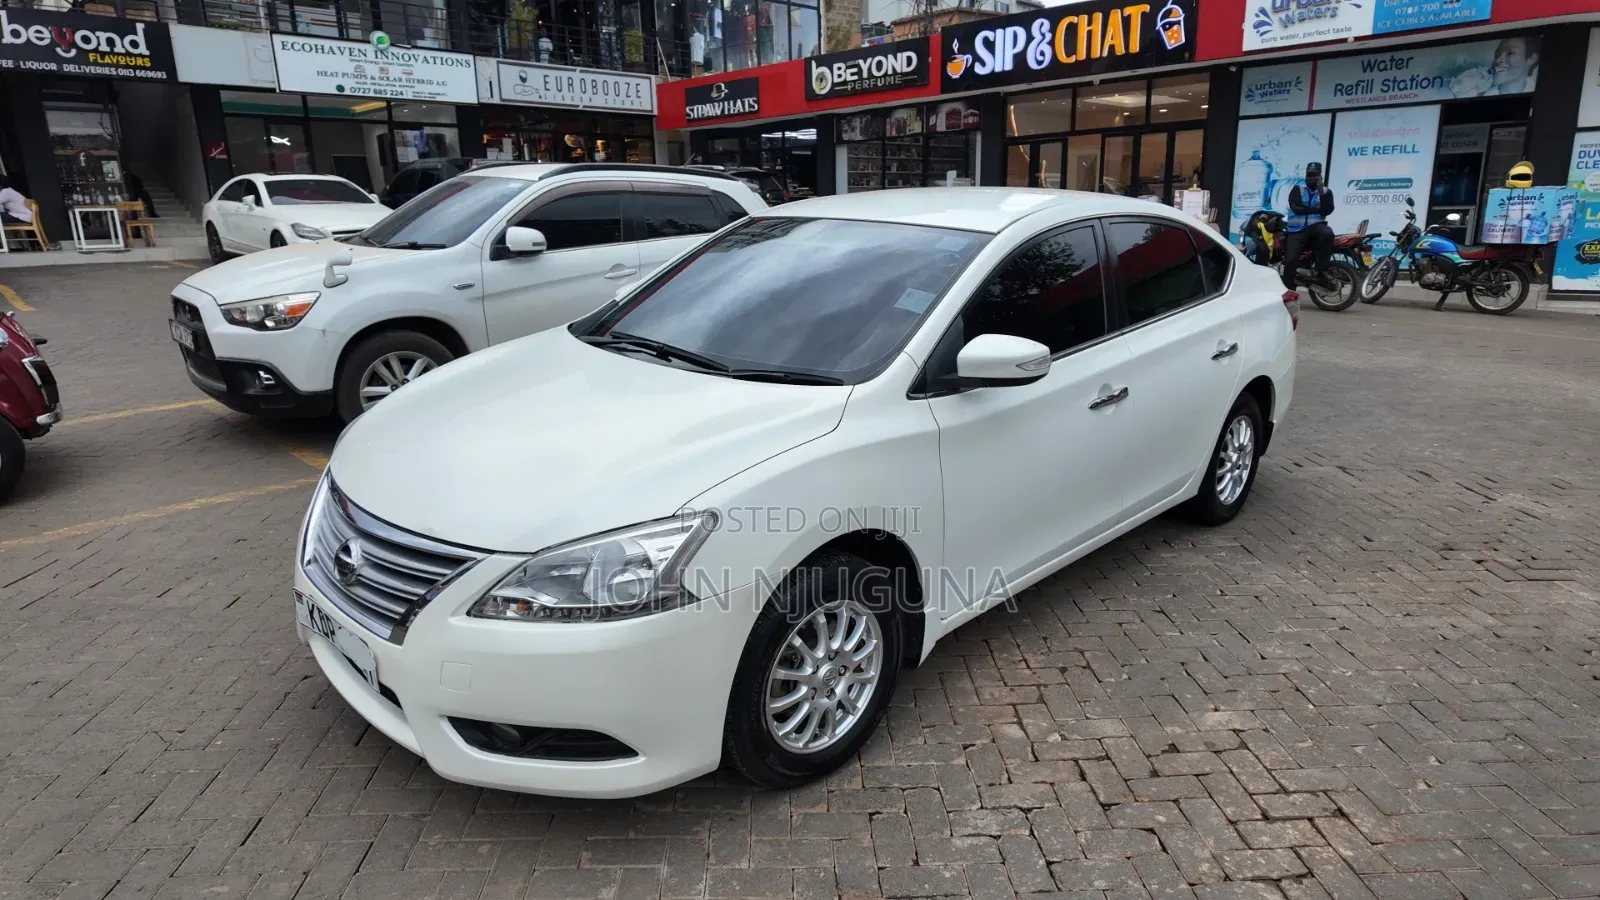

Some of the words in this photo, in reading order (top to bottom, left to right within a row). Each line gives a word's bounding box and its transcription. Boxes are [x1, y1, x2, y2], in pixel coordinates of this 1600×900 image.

[1278, 6, 1338, 28] Waters
[0, 10, 150, 57] beyond
[1261, 36, 1278, 44] pure
[1303, 28, 1331, 38] perfect
[1333, 26, 1353, 34] taste
[88, 53, 151, 67] FLAVOURS
[280, 40, 368, 58] ECOHAVEN
[374, 49, 471, 69] INNOVATIONS
[20, 60, 58, 70] LIQUOR
[63, 63, 117, 75] DELIVERIES
[832, 51, 918, 83] BEYOND
[1361, 55, 1415, 73] Water
[316, 70, 339, 78] HEAT
[341, 72, 368, 80] PUMPS
[405, 77, 434, 85] HYBRID
[847, 75, 902, 90] PERFUME
[1254, 80, 1292, 90] urban
[1333, 78, 1375, 97] Refill
[1380, 74, 1444, 93] Station
[350, 86, 371, 94] 0727
[373, 88, 388, 96] 885
[389, 89, 404, 97] 224
[543, 74, 642, 99] EUROBOOZE
[724, 97, 758, 114] HATS
[1345, 95, 1387, 105] WESTLANDS
[1388, 93, 1419, 101] BRANCH
[1347, 146, 1369, 156] WE
[1372, 144, 1420, 155] REFILL
[1345, 194, 1370, 204] 0708
[1371, 194, 1390, 203] 700
